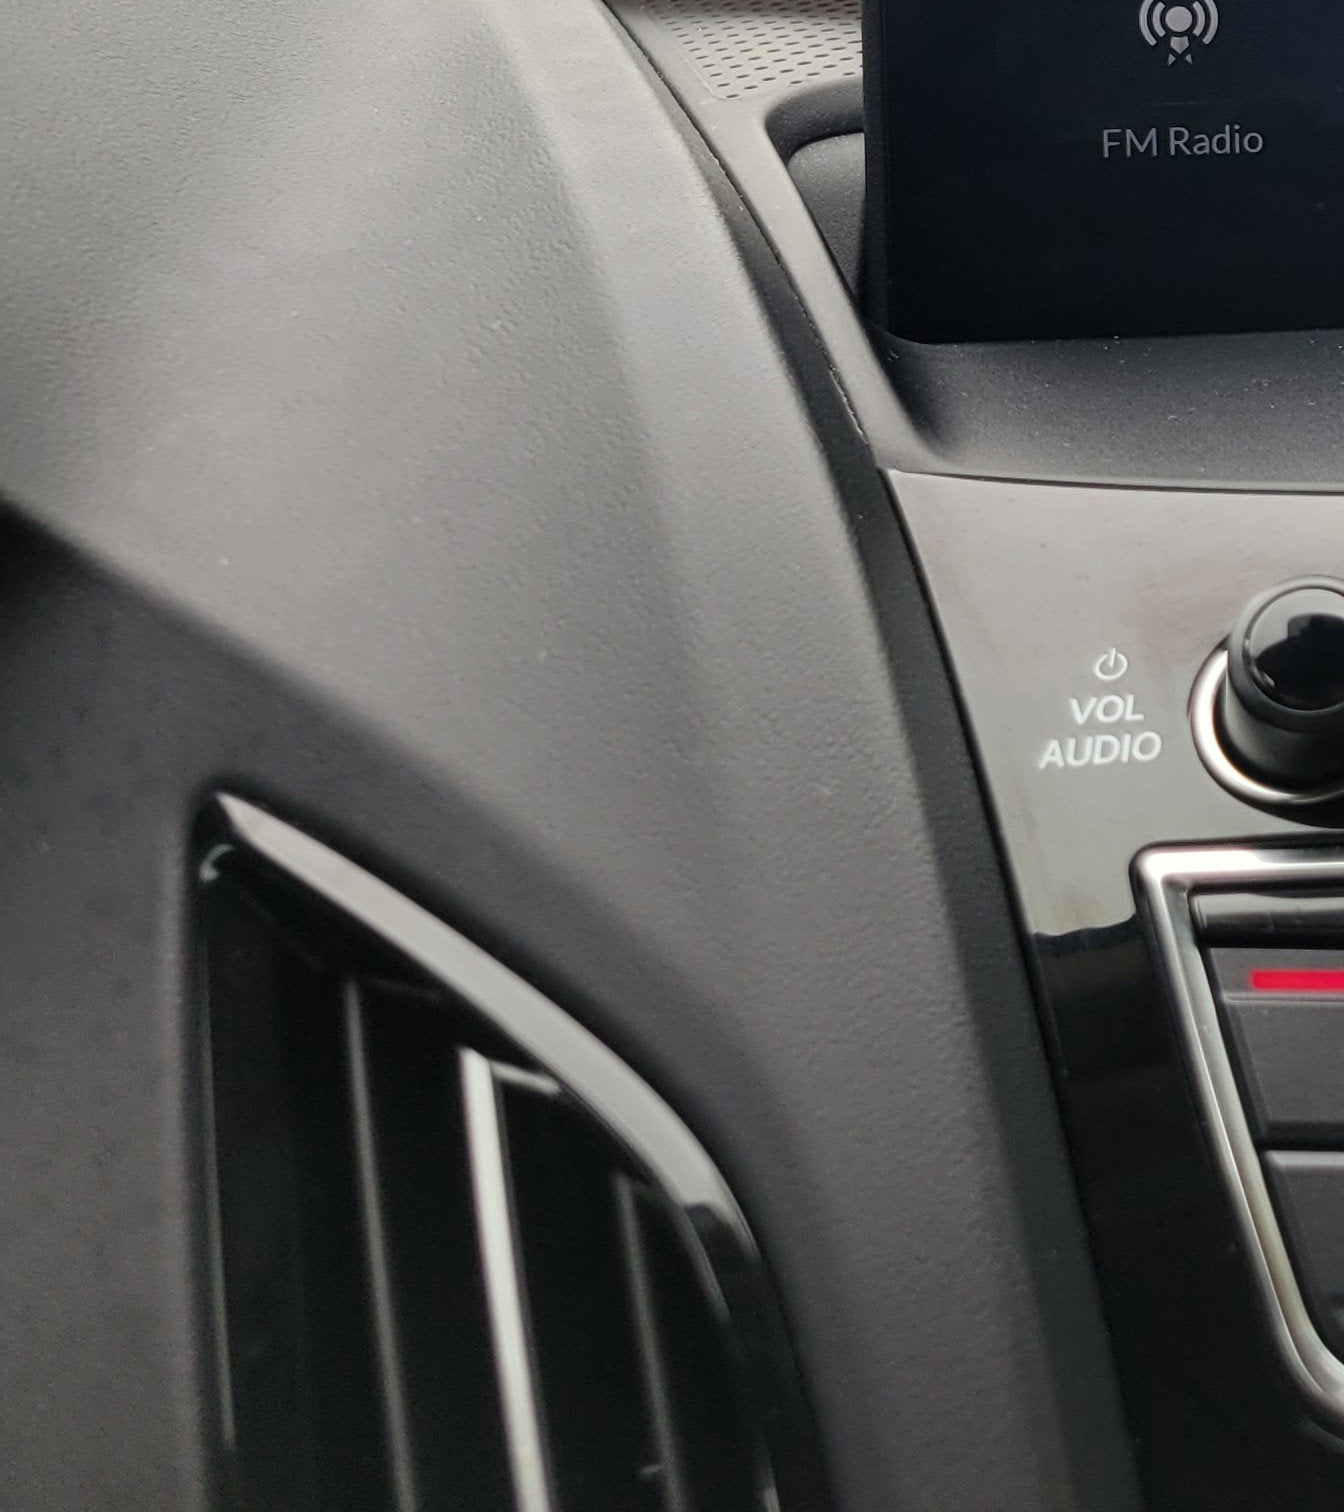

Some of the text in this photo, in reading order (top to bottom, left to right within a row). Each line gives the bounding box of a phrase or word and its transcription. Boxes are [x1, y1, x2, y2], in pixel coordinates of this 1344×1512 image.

[1102, 124, 1264, 157] FM Radio
[1070, 693, 1144, 725] VOL
[1039, 731, 1163, 770] AUDIO
